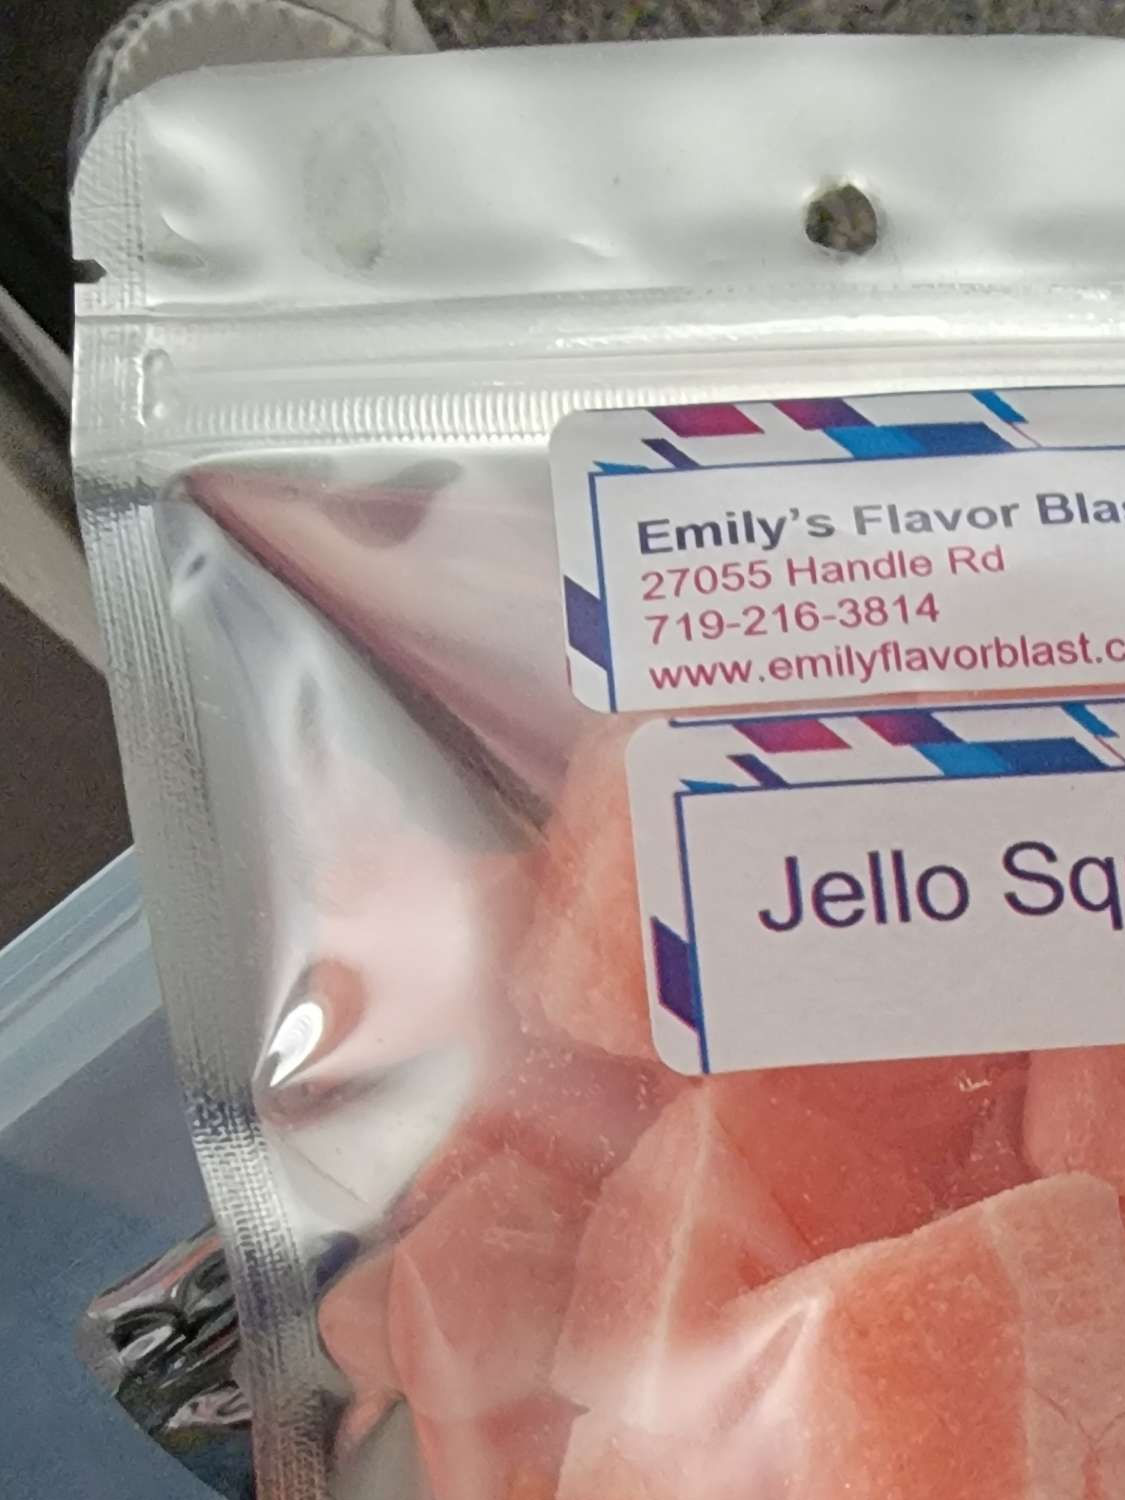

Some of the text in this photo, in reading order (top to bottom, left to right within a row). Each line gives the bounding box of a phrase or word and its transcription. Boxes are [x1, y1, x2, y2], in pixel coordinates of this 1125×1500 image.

[638, 507, 835, 554] Emily's
[853, 503, 1020, 536] Flavor
[641, 544, 1005, 601] 27055 Handle Rd
[645, 592, 939, 645] 719-216-3814
[758, 849, 970, 932] Jello
